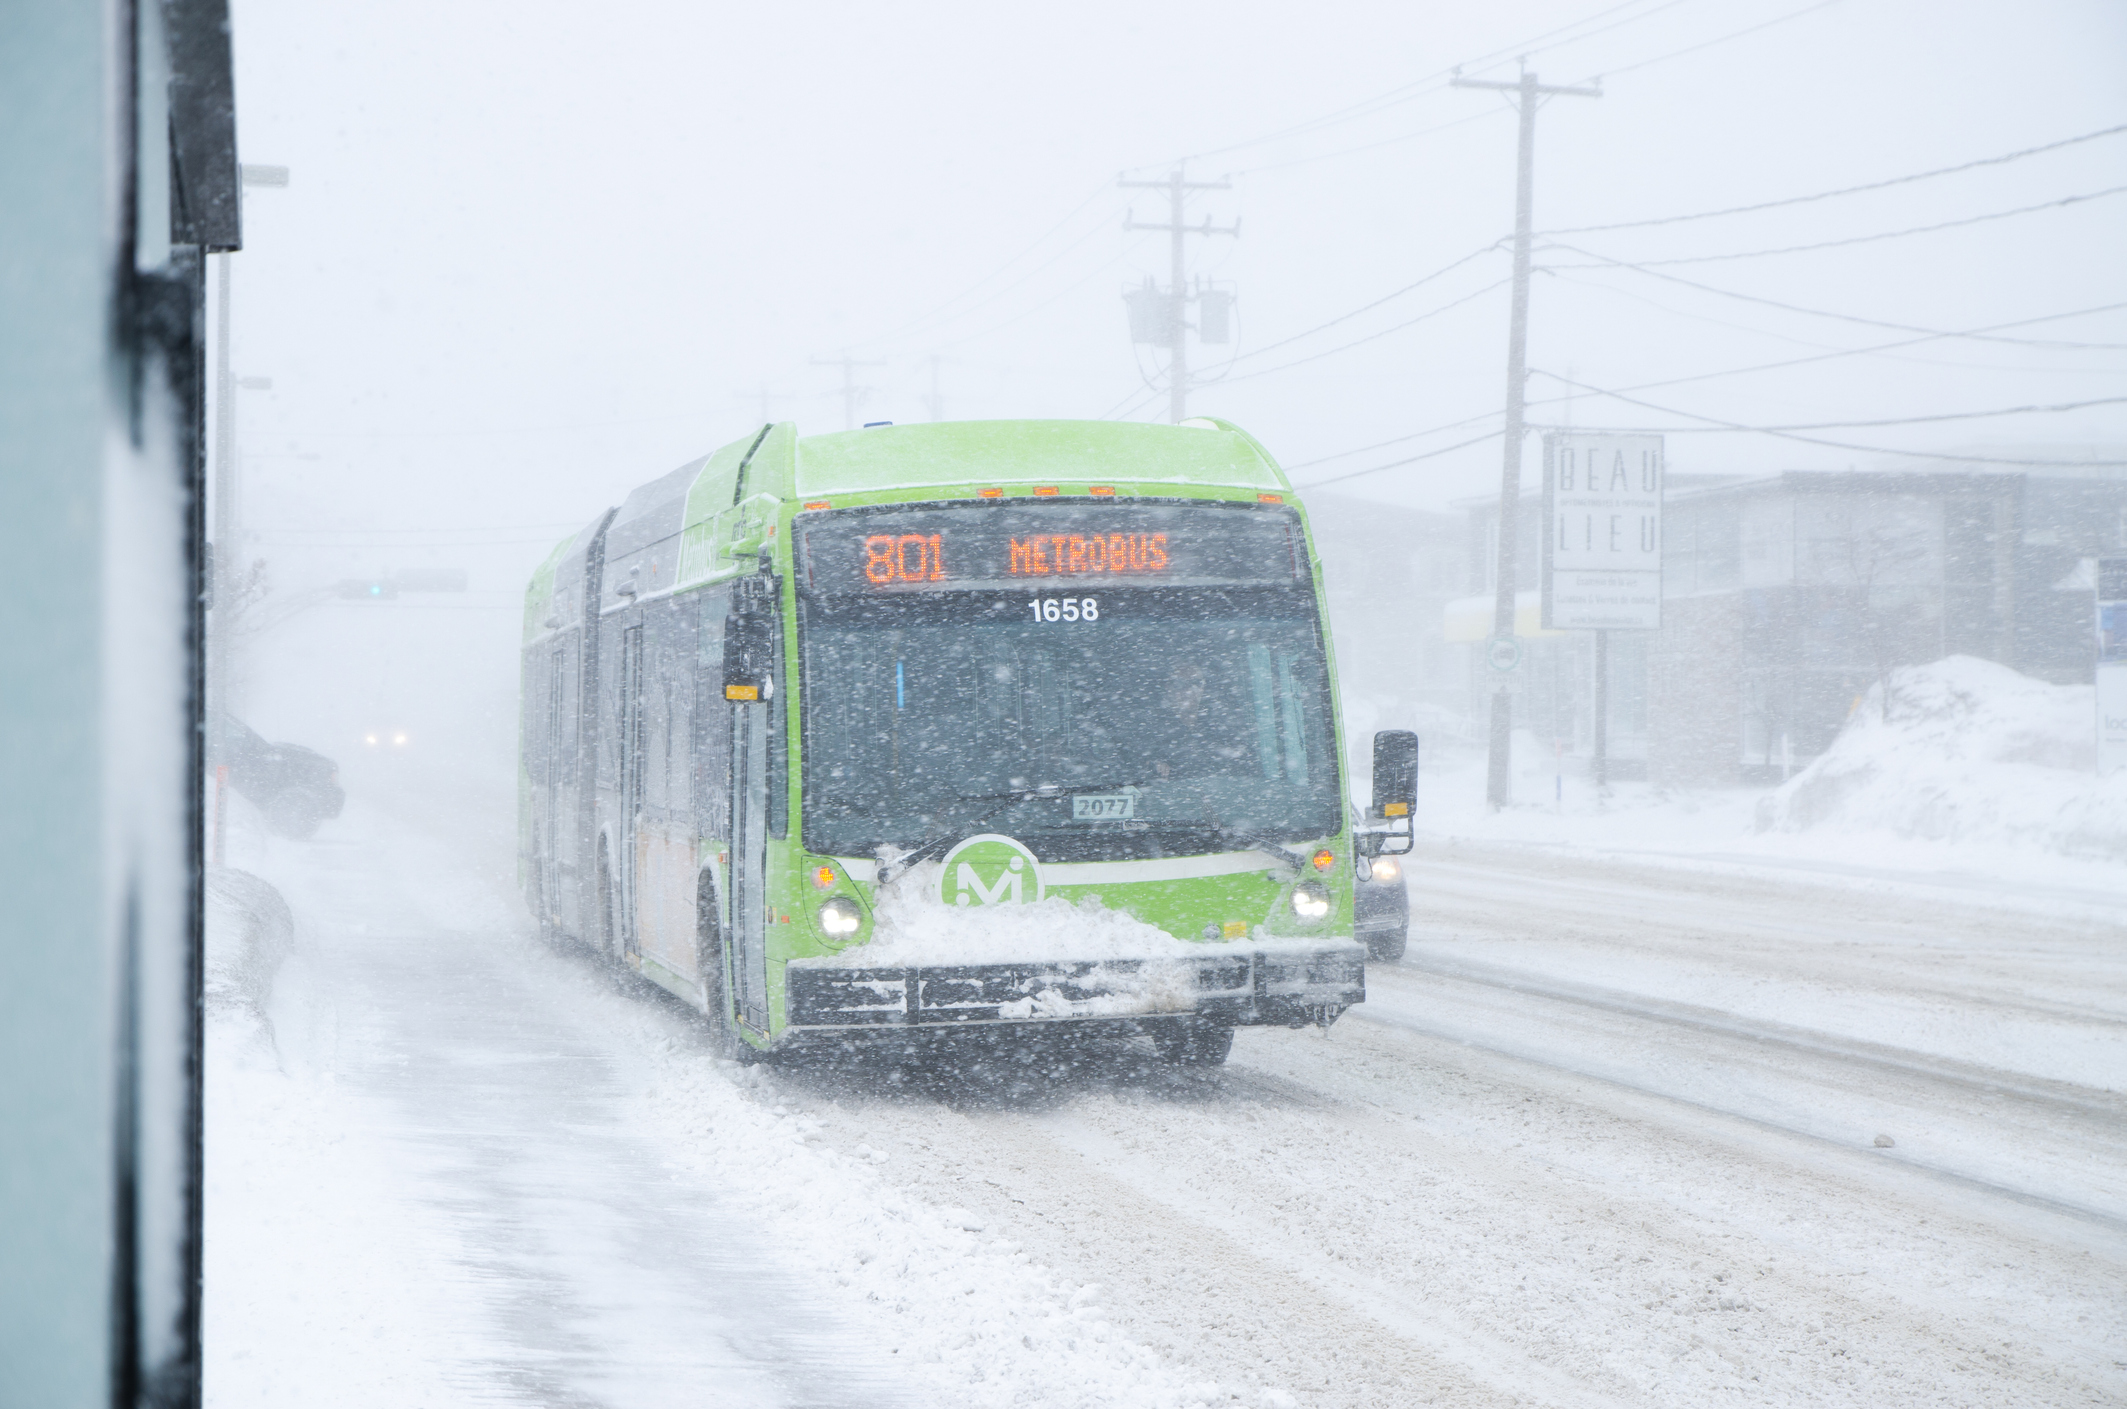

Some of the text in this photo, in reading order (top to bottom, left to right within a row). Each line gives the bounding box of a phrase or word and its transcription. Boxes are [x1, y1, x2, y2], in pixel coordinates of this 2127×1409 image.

[1559, 447, 1657, 493] BEAU
[1559, 513, 1656, 552] LIEU
[865, 534, 945, 582] 801
[1010, 533, 1168, 573] METROBUS
[1028, 598, 1099, 622] 1658
[1078, 798, 1129, 816] 2077
